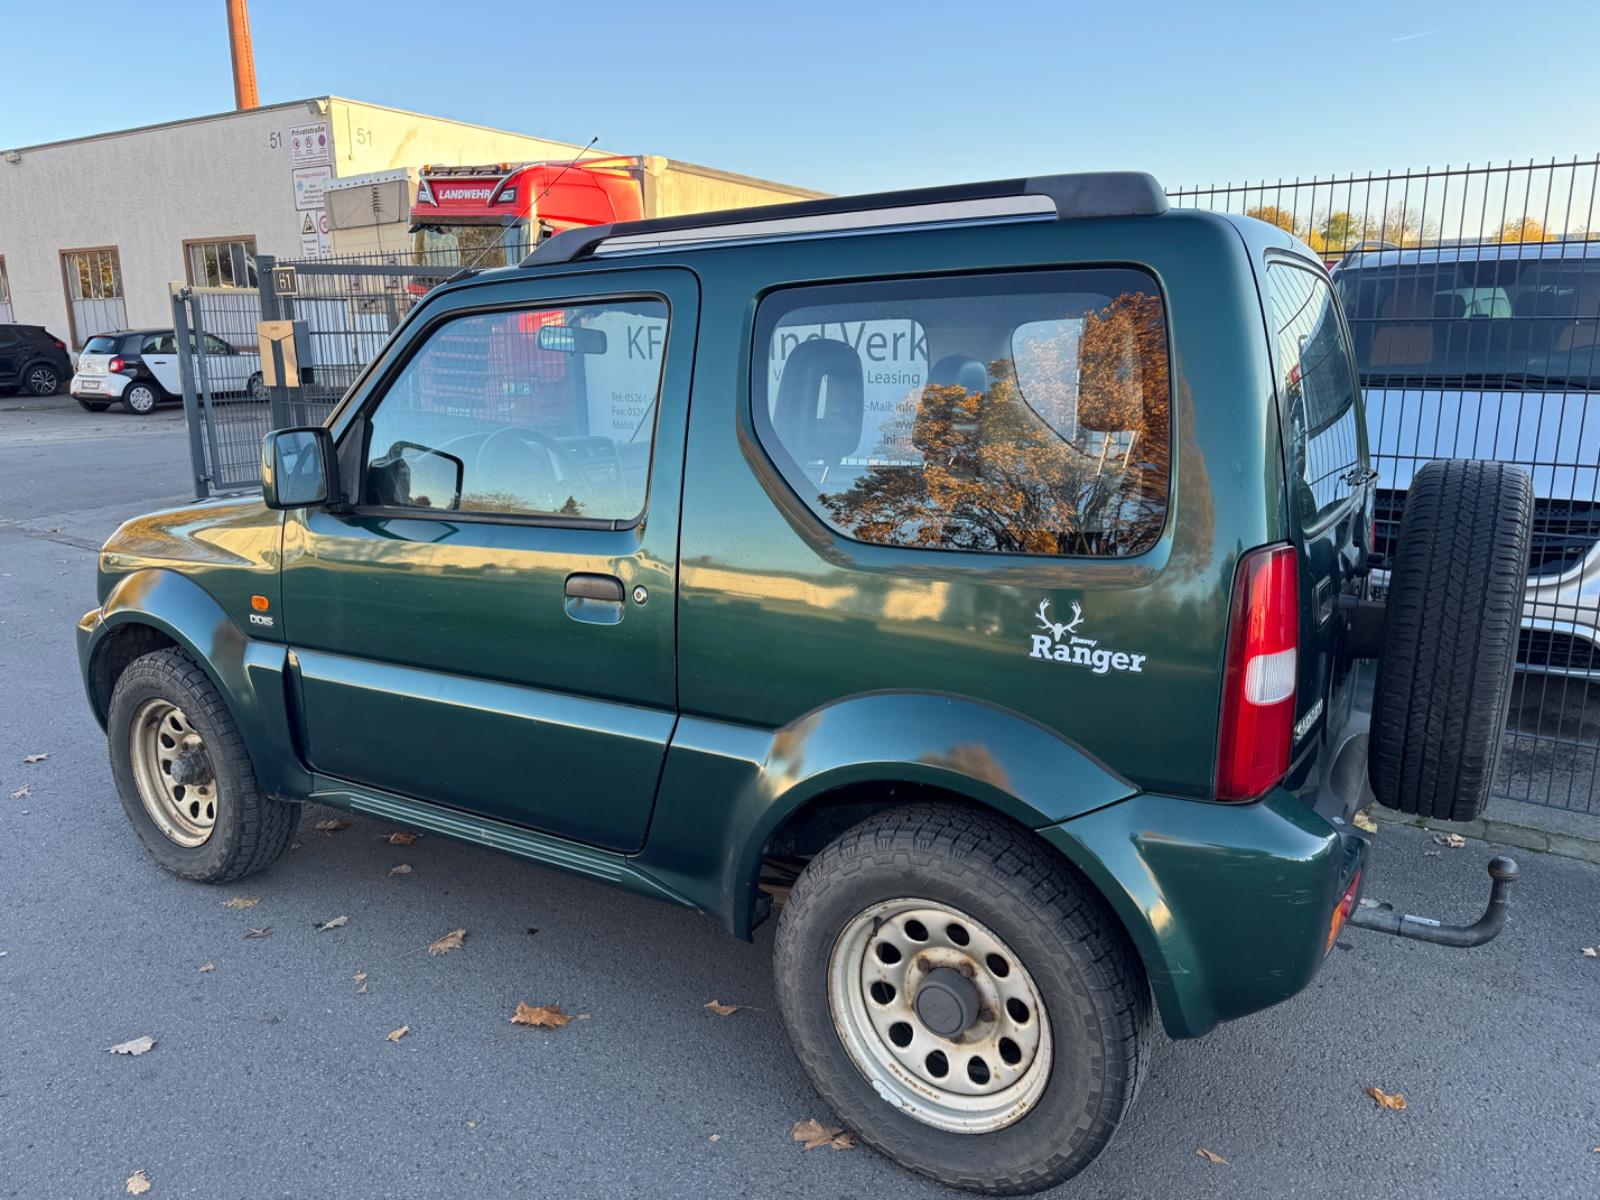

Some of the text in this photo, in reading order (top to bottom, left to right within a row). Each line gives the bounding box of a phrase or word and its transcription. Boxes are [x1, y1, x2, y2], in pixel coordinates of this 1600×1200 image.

[269, 131, 282, 149] 51
[357, 127, 373, 146] 51
[439, 189, 492, 200] LANDWEHR
[867, 371, 921, 387] Leasing
[1030, 634, 1146, 674] Ranger
